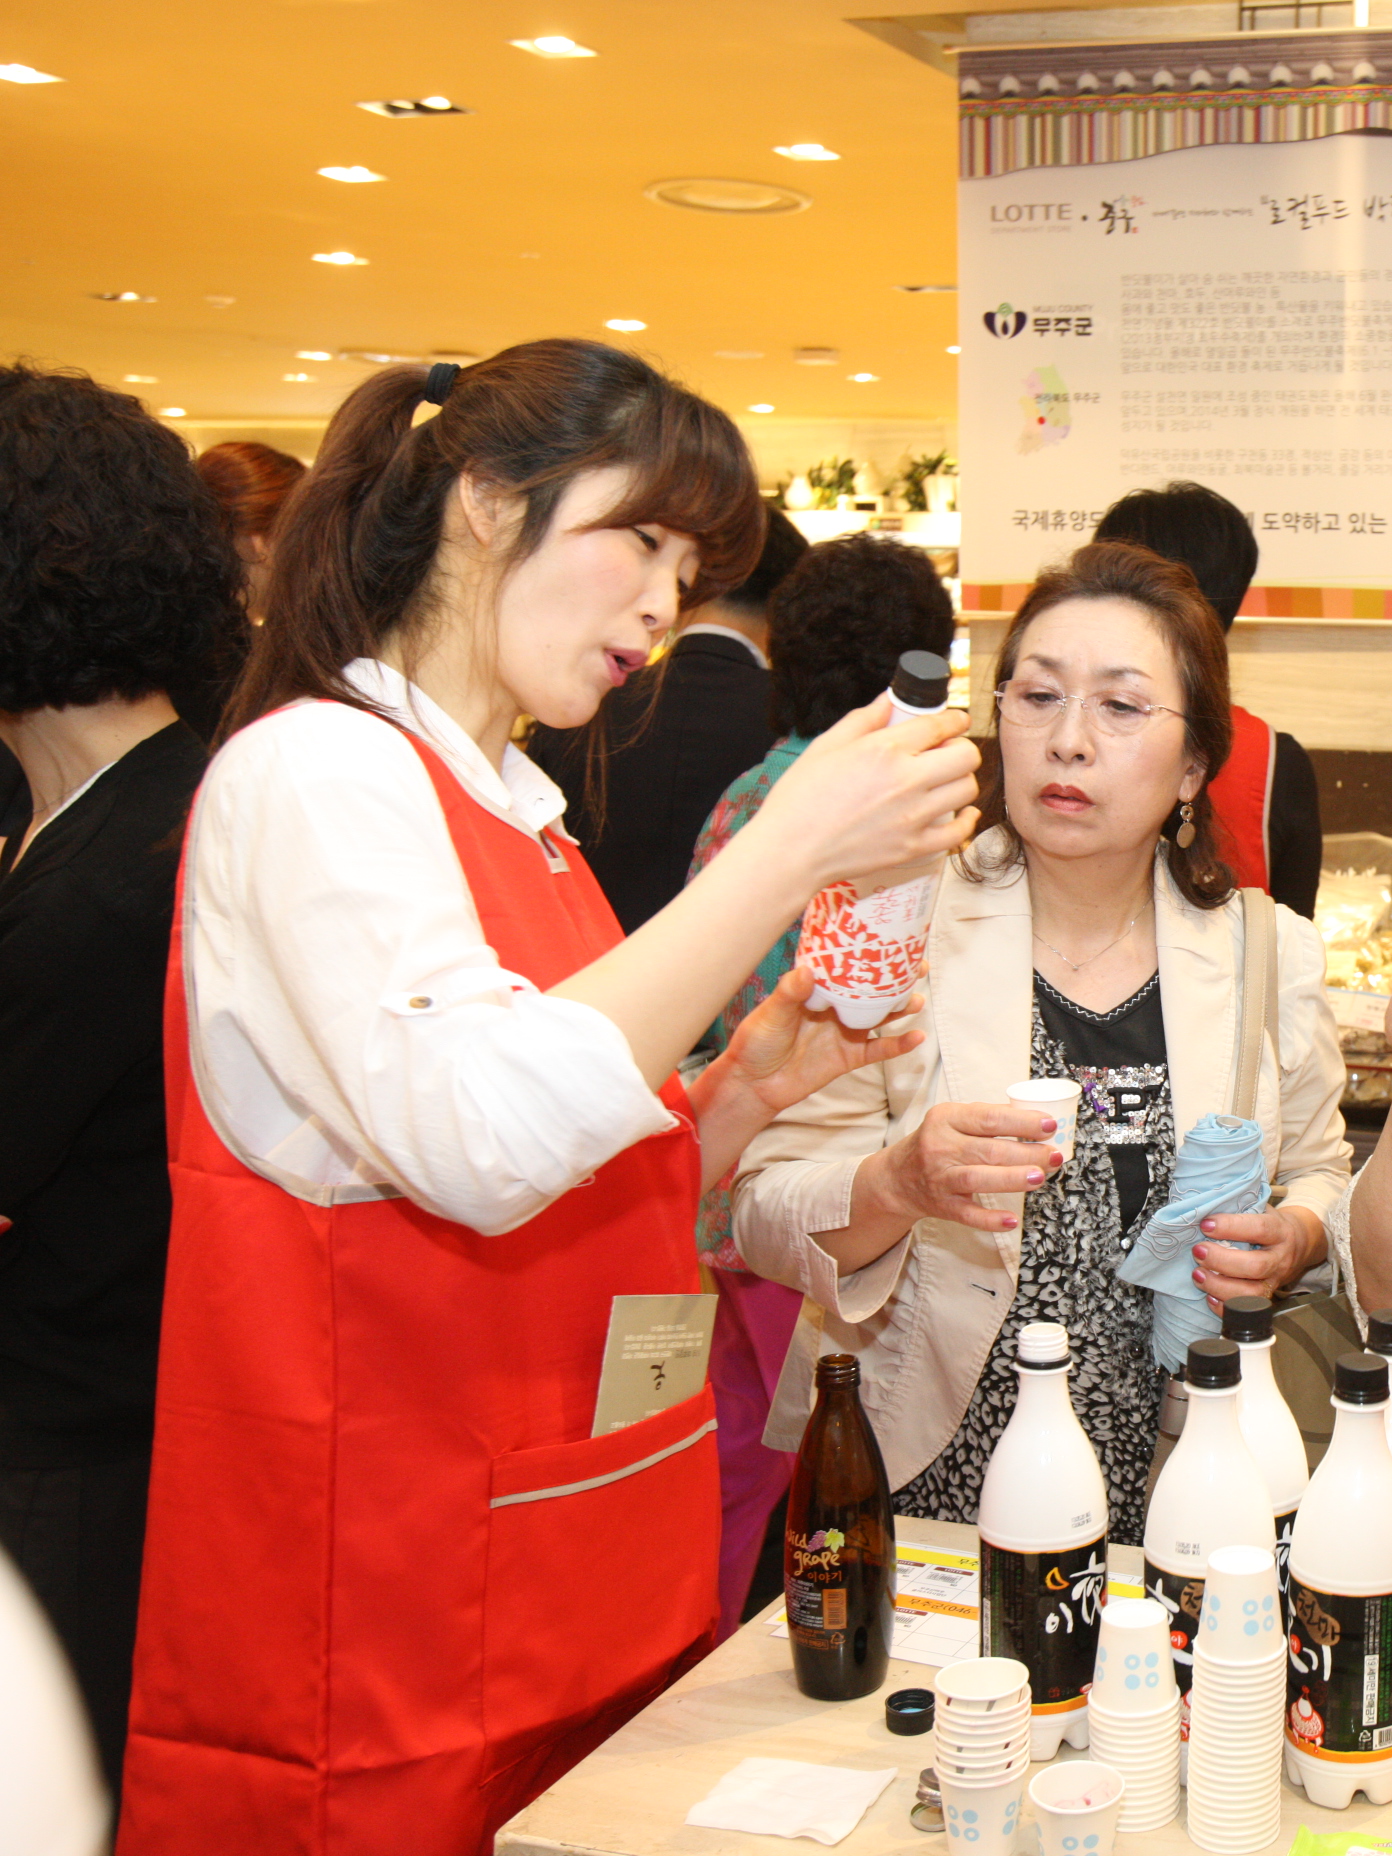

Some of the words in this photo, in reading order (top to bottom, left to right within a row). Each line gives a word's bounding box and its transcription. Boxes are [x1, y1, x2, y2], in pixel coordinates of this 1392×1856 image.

[990, 203, 1071, 222] LOTTE
[1058, 304, 1093, 313] COUNTY
[1033, 317, 1092, 337] 무주군
[1261, 512, 1341, 534] 도약하고
[1349, 512, 1387, 534] 있는
[807, 1571, 842, 1583] 이야기
